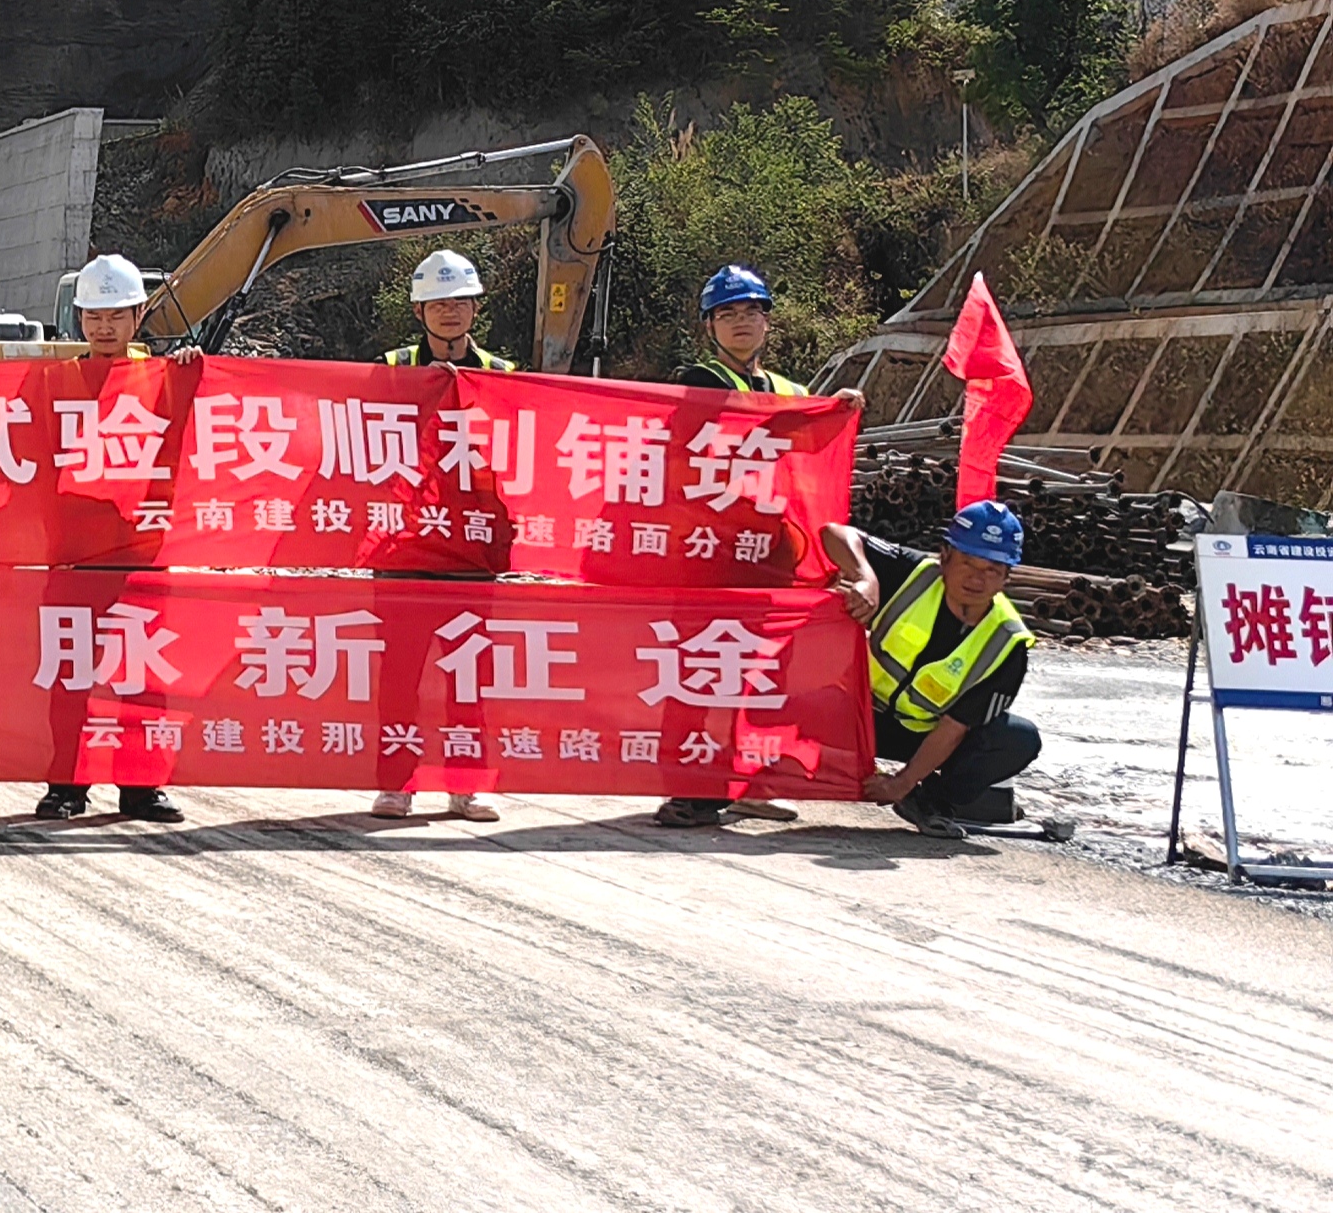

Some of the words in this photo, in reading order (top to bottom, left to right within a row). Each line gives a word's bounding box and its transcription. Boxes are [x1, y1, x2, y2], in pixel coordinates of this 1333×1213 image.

[383, 203, 455, 224] SANY
[133, 498, 775, 565] 云南建投那兴高速路面分部
[82, 716, 780, 768] 云南建投那兴高速路面分部
